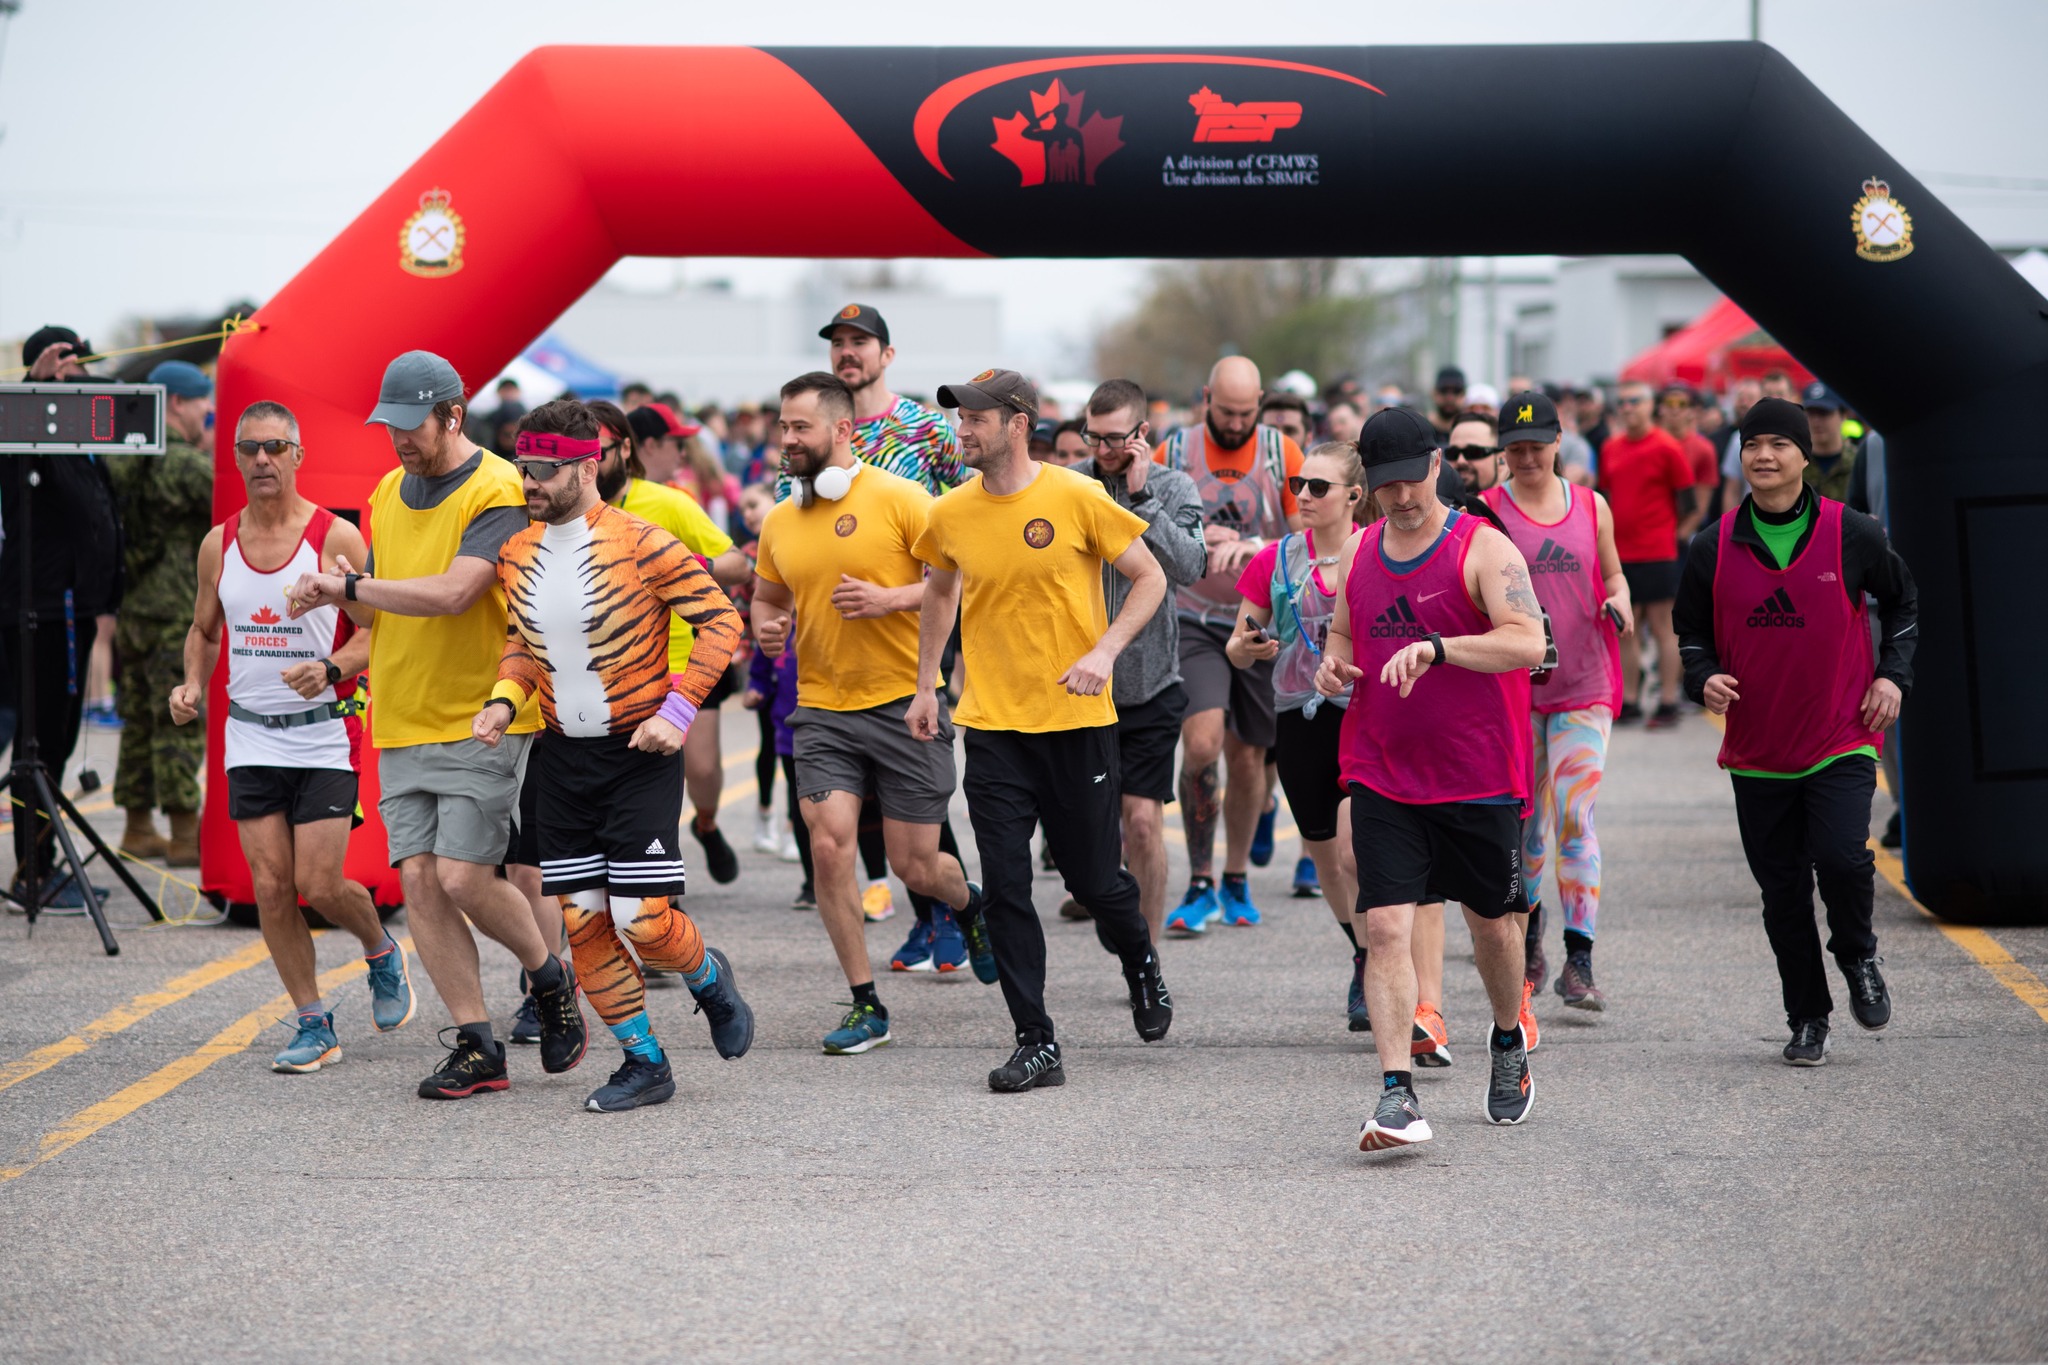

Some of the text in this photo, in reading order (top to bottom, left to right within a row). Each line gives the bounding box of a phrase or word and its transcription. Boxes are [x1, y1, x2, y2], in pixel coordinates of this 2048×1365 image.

[1162, 154, 1319, 170] A division of CFMWS
[1162, 171, 1319, 185] Une division des SBMFC
[1746, 612, 1806, 628] adidas
[234, 625, 303, 634] CANADIAN ARMED
[1369, 622, 1426, 638] adidas
[244, 636, 288, 647] FORCES
[255, 649, 315, 658] CANADIENNES
